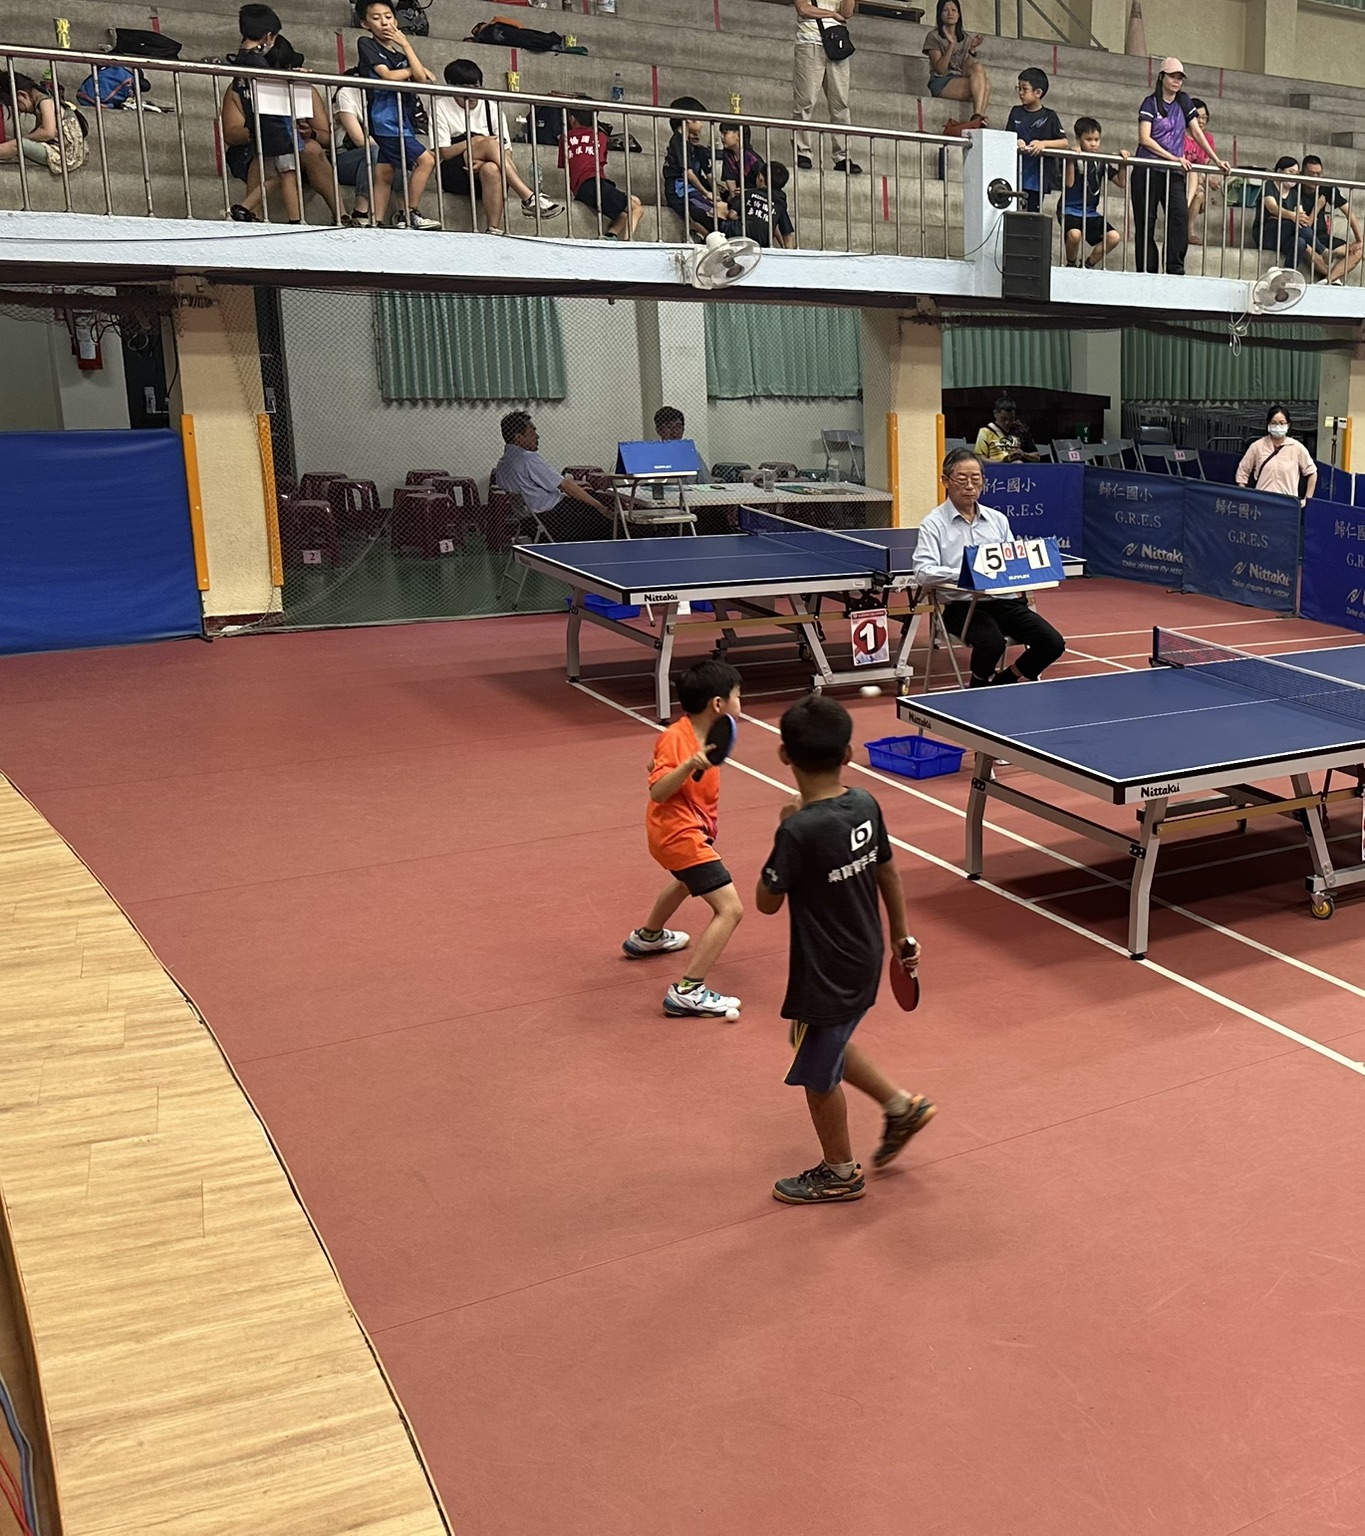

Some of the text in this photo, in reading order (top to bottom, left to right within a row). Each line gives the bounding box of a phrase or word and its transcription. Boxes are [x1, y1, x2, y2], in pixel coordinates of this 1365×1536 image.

[1099, 480, 1154, 502] 歸仁國小
[1115, 510, 1163, 529] G.R.E.S
[1215, 498, 1262, 521] 歸仁國小
[1228, 529, 1269, 548] G.R.E.S
[986, 543, 1045, 571] 5 0 2 1
[1250, 562, 1291, 587] Nittaku
[644, 593, 678, 602] Nittaku
[859, 622, 876, 651] 1
[908, 712, 932, 729] Nittaku
[1141, 782, 1180, 798] Nittaku
